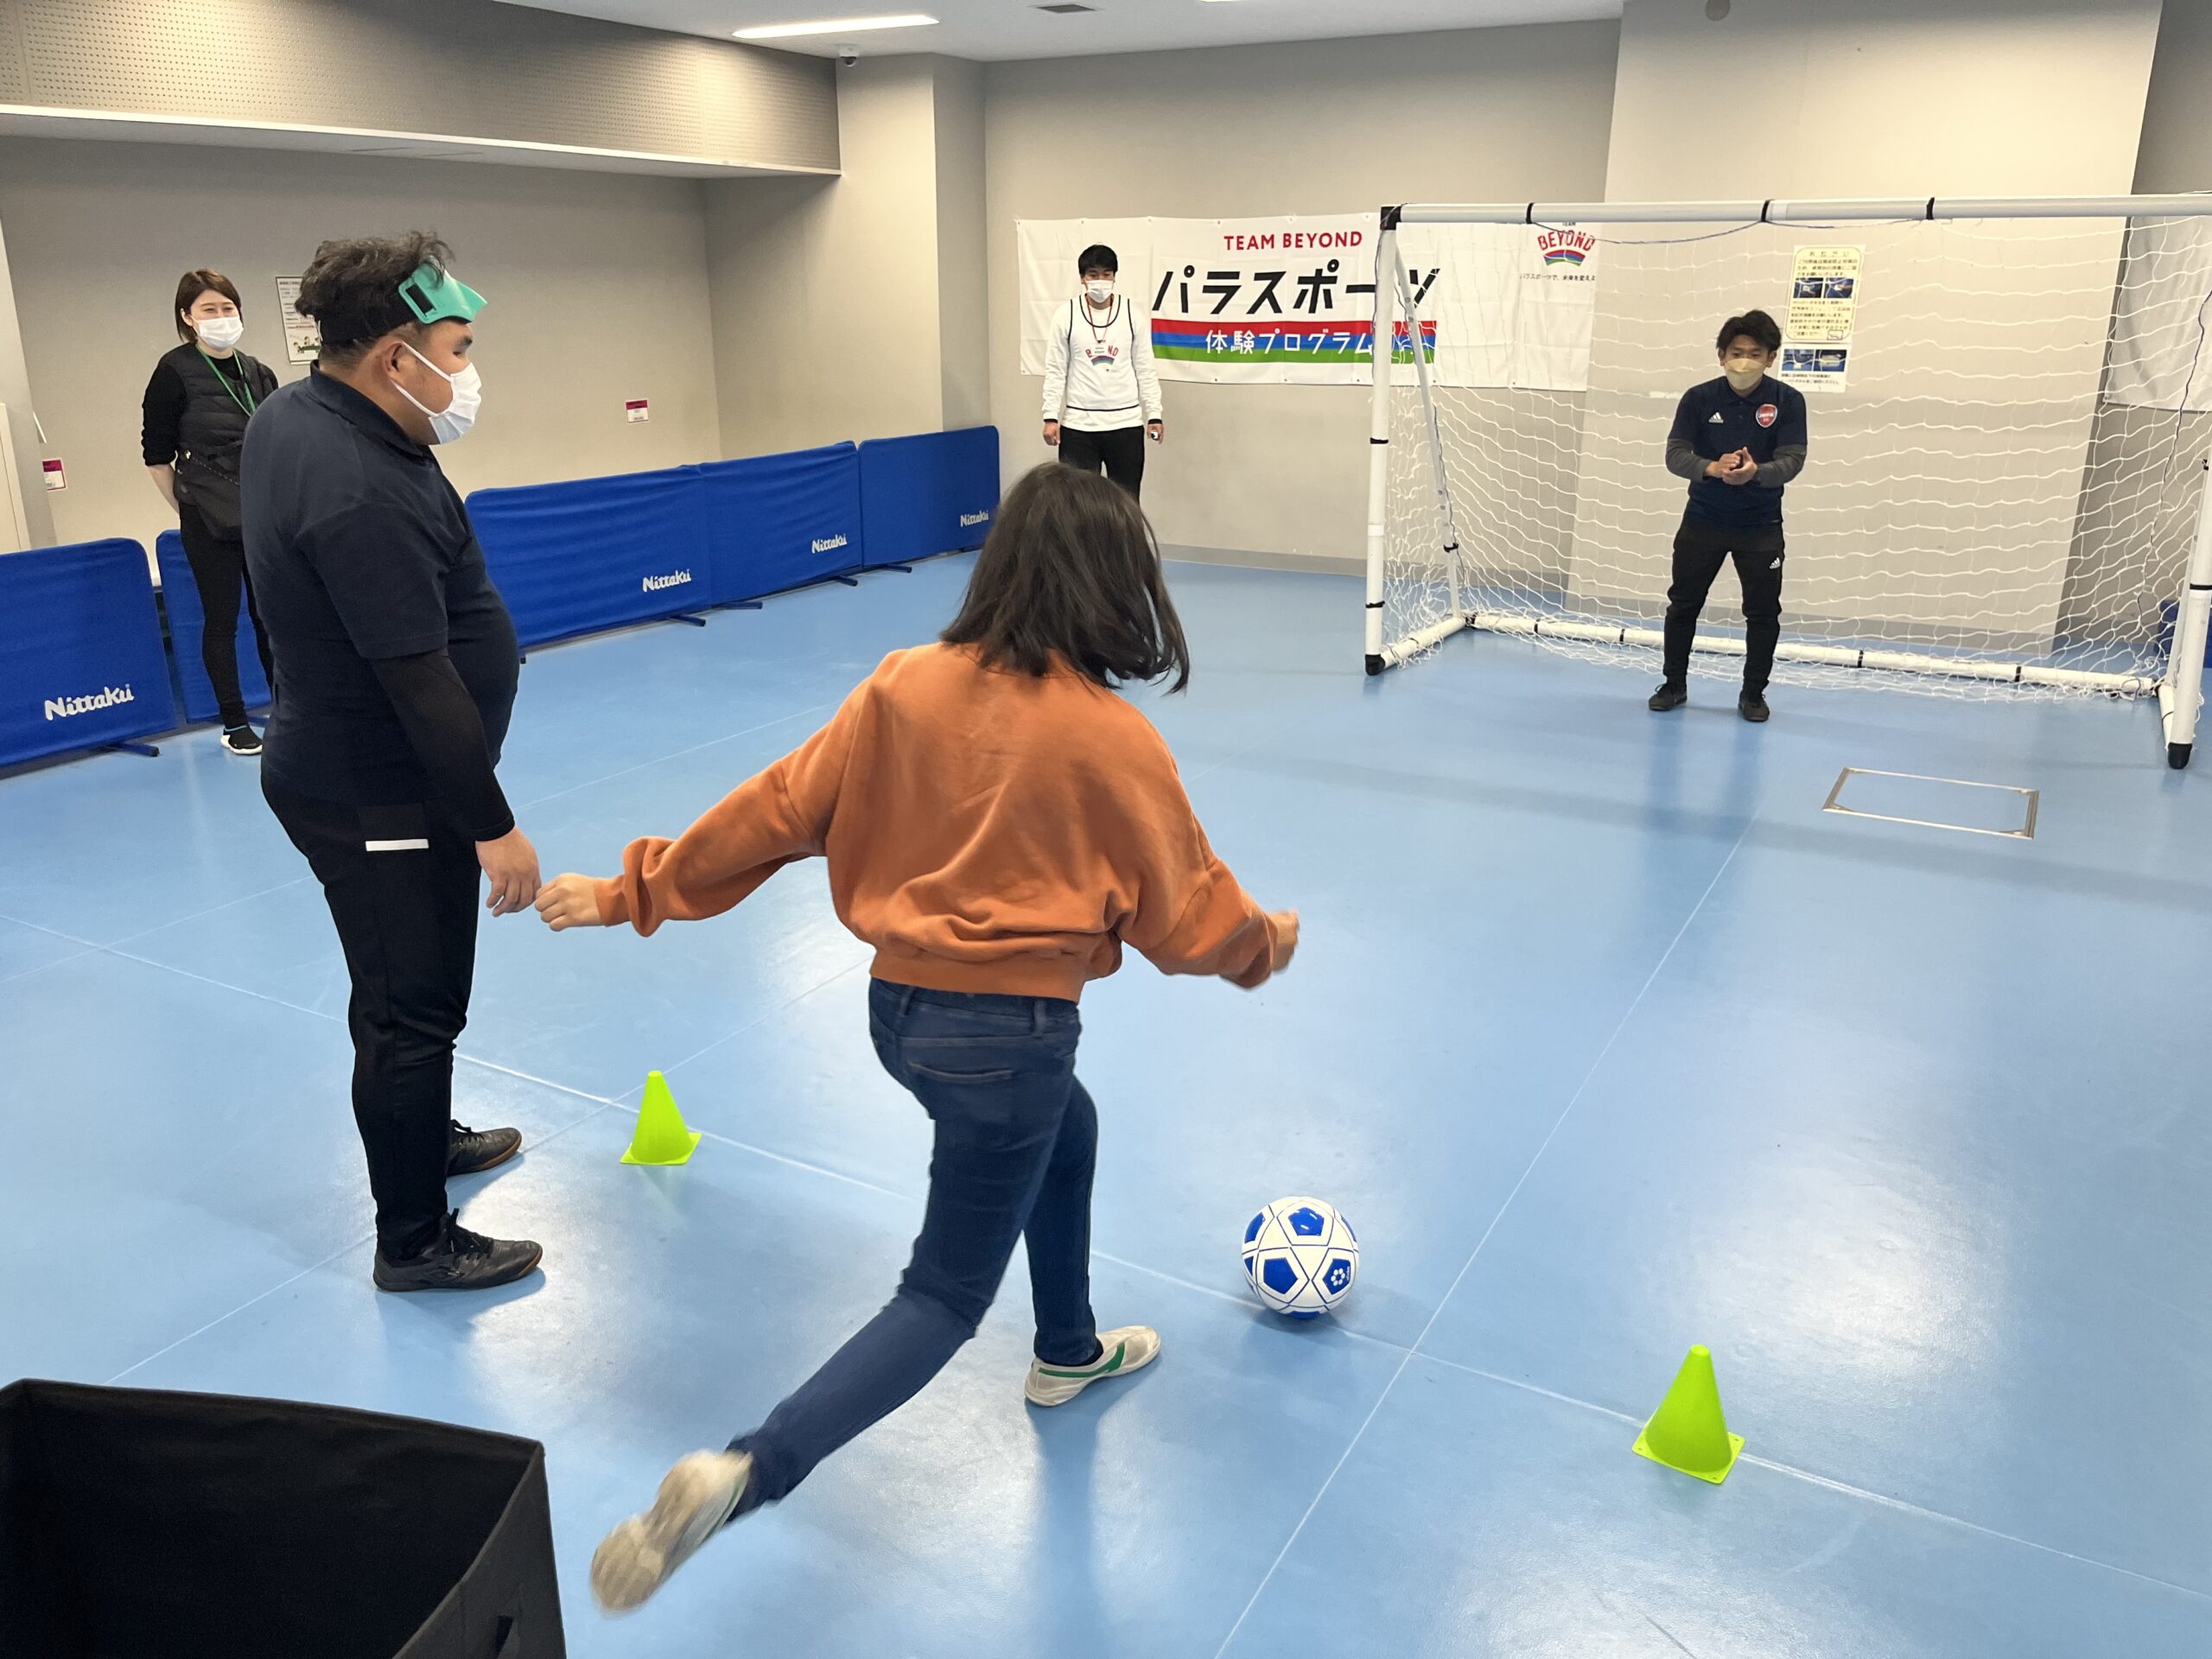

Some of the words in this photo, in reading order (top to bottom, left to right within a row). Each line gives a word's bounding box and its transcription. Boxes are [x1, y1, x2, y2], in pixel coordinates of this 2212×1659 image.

[1224, 234, 1274, 251] TEAM
[1282, 231, 1363, 249] BEYOND
[1537, 229, 1596, 251] BEYOND
[1085, 345, 1119, 358] BND
[1205, 327, 1373, 355] 体験プログラム
[44, 683, 135, 721] Nittaku
